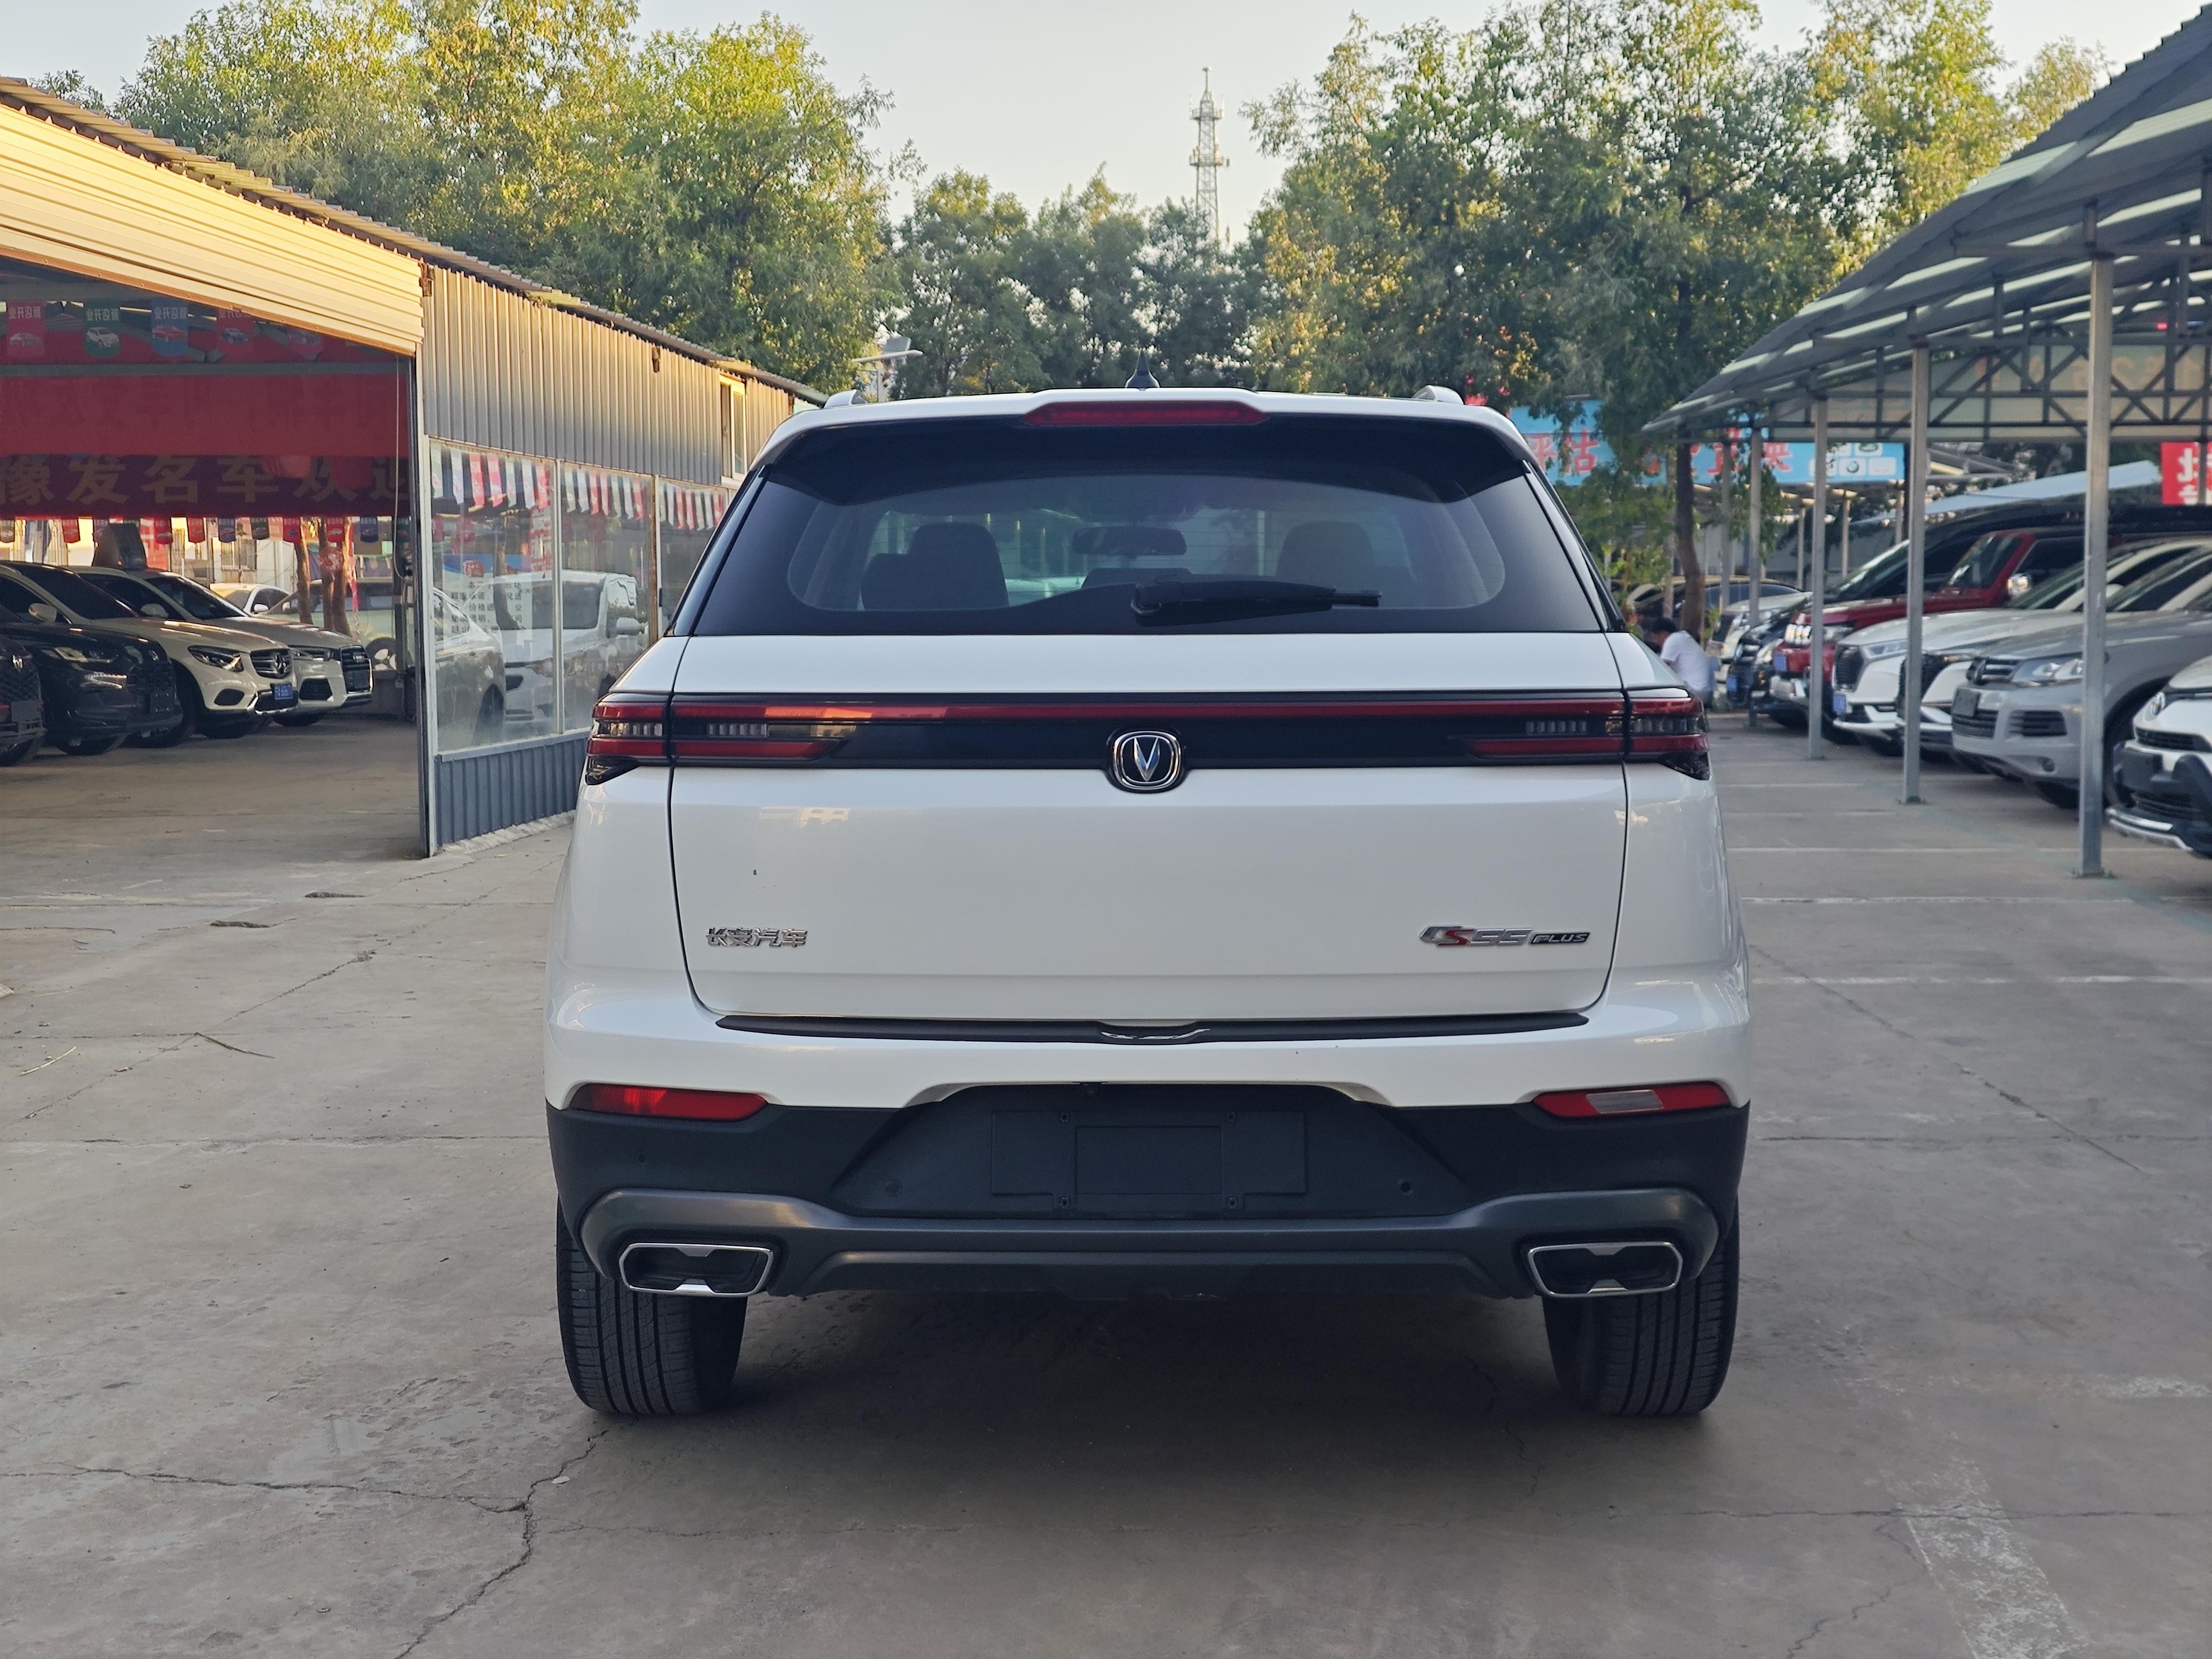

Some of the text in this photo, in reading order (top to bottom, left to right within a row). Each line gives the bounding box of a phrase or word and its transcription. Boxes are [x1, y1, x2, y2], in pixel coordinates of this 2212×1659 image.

[706, 926, 808, 948] 长安汽车
[1420, 925, 1590, 947] CS55 PLUS
